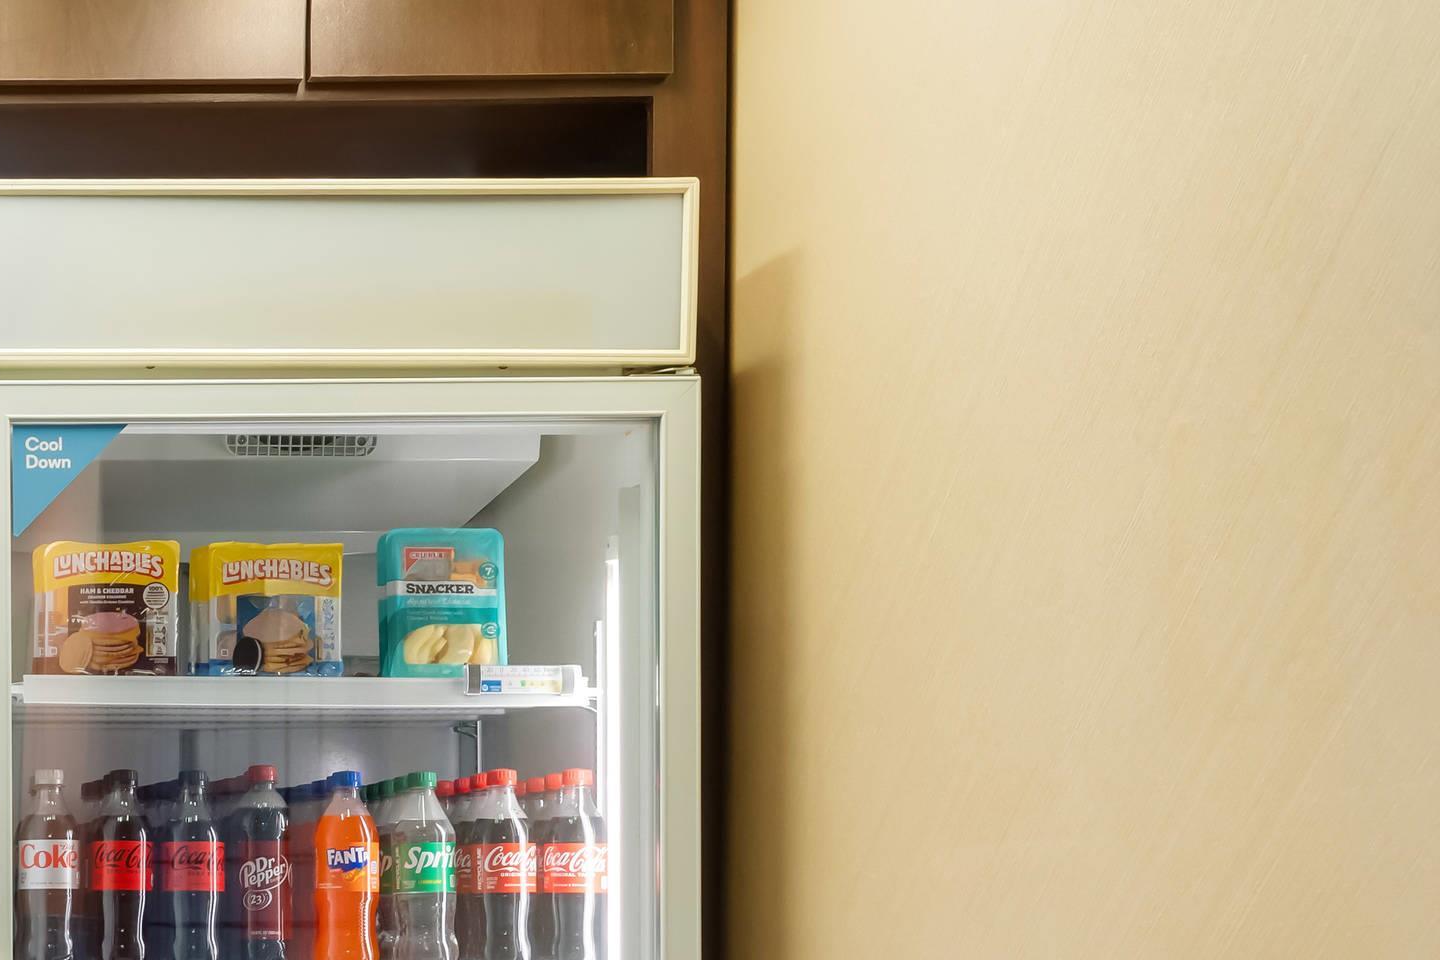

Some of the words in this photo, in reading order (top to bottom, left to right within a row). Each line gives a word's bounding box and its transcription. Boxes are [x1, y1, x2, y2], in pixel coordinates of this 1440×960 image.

[25, 437, 62, 451] Cool
[26, 455, 71, 469] Down
[53, 550, 164, 578] LUNCHABLES
[222, 558, 334, 586] LUNCHABLES
[406, 583, 474, 594] SNACKER
[21, 843, 78, 869] Coke
[255, 856, 275, 873] Dr
[404, 844, 456, 874] Sprit
[243, 860, 286, 888] Pepper
[250, 894, 262, 905] 23
